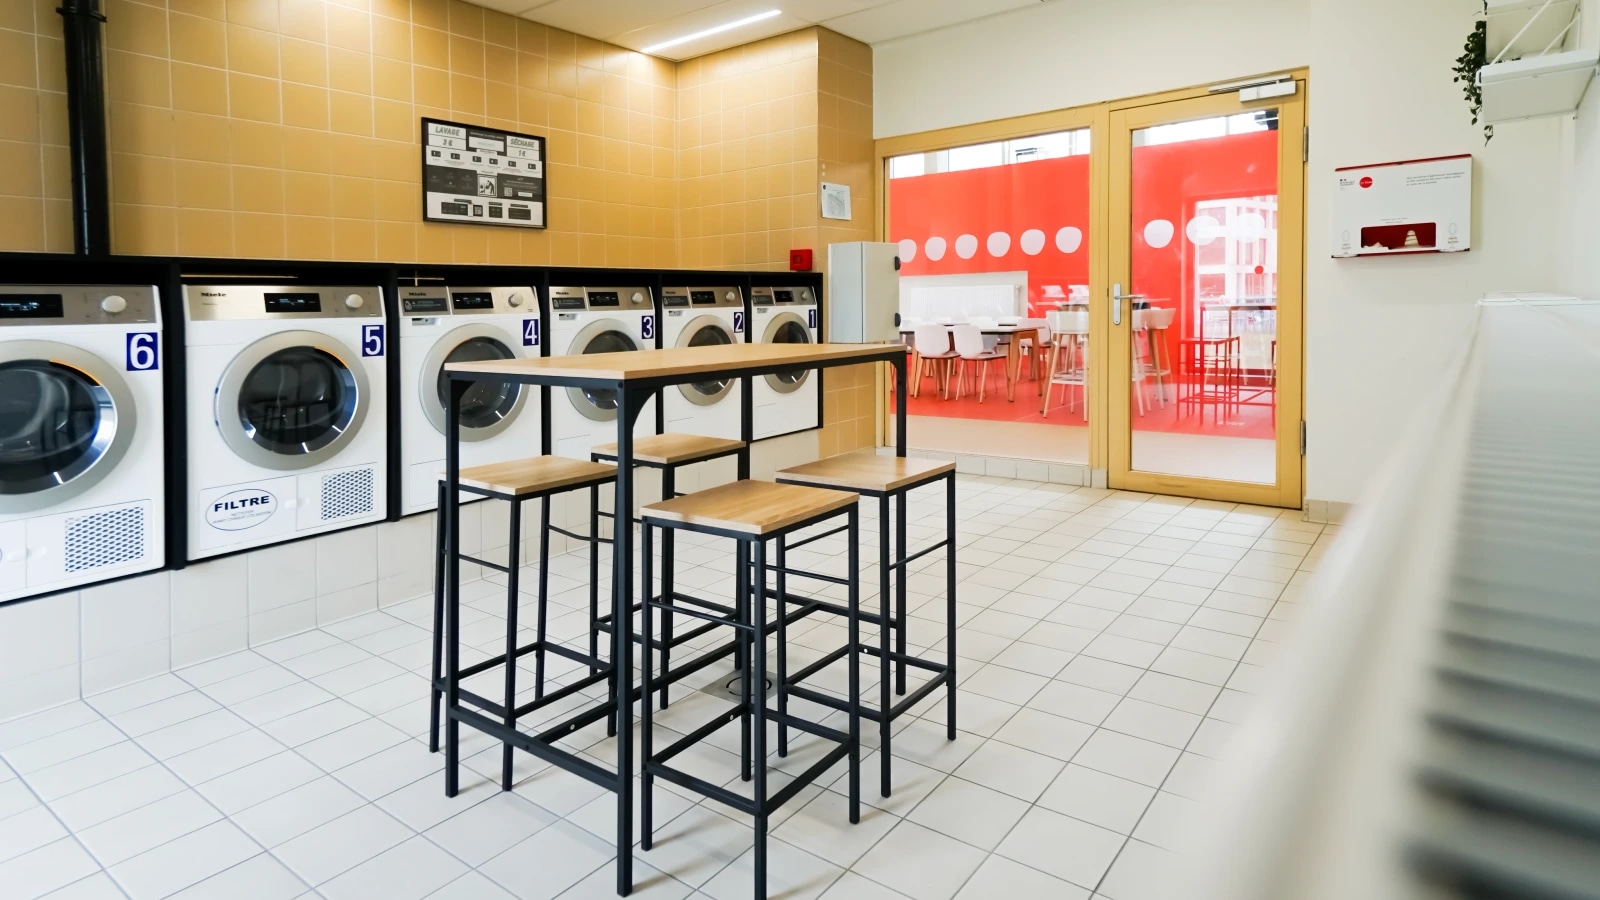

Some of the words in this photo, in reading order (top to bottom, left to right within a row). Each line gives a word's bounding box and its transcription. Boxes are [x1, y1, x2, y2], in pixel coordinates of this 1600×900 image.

[435, 126, 460, 136] LAVAGE
[510, 138, 535, 148] SÉCHAGE
[643, 316, 653, 339] 3
[734, 312, 743, 332] 2
[810, 310, 815, 328] 1
[365, 326, 381, 356] 5
[524, 320, 537, 345] 4
[130, 333, 154, 369] 6
[214, 495, 270, 512] FILTRE
